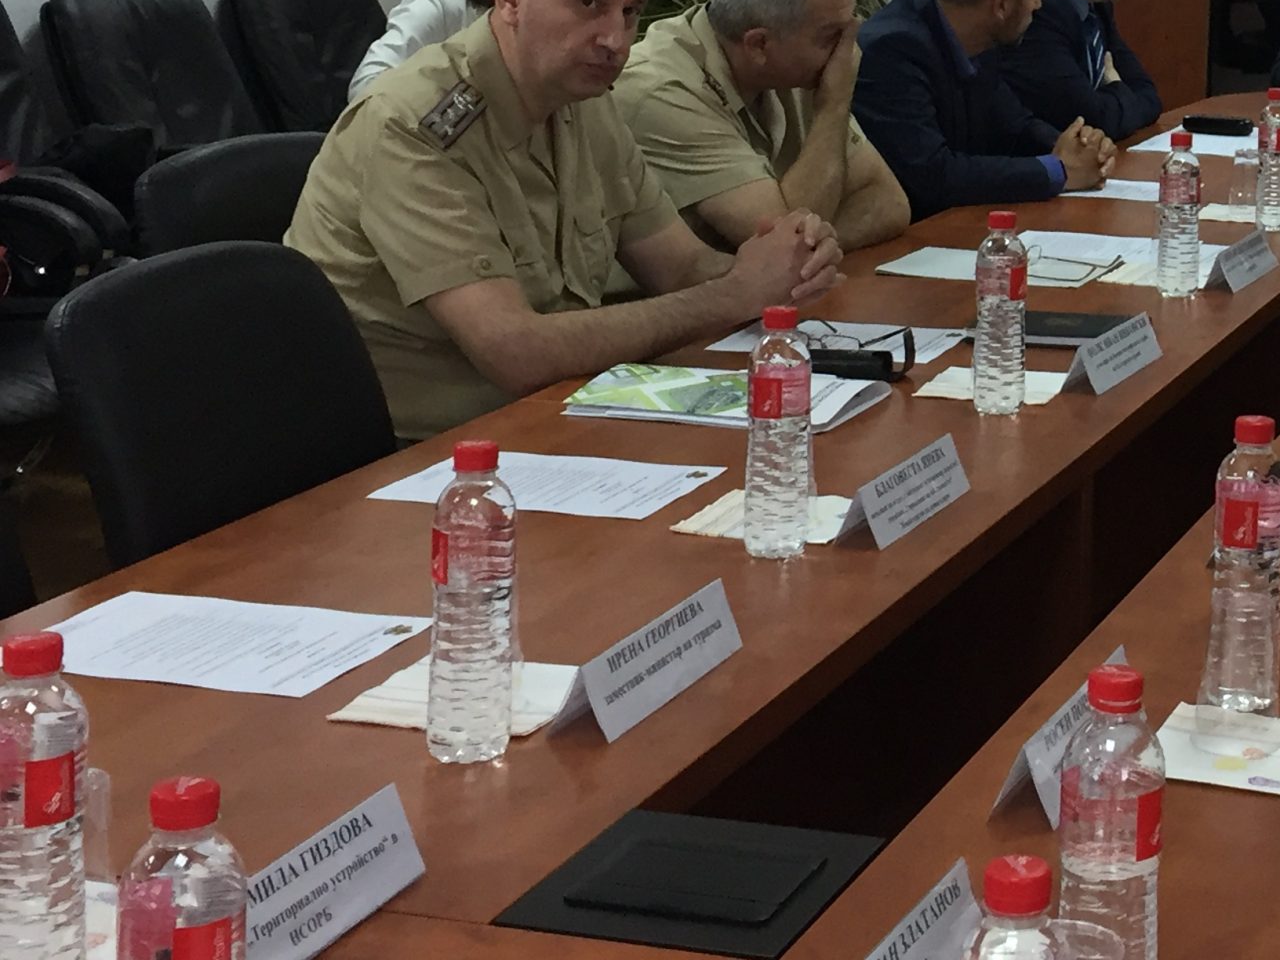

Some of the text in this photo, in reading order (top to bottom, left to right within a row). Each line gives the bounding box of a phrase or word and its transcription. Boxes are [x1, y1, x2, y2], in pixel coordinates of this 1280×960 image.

[605, 599, 705, 674] ИРЕНА ГЕОРГИЕВА
[247, 812, 374, 909] МИЛА ГИЗДОВА
[288, 905, 334, 946] НСОРБ
[898, 878, 962, 955] ЗЛАТАНОВ
